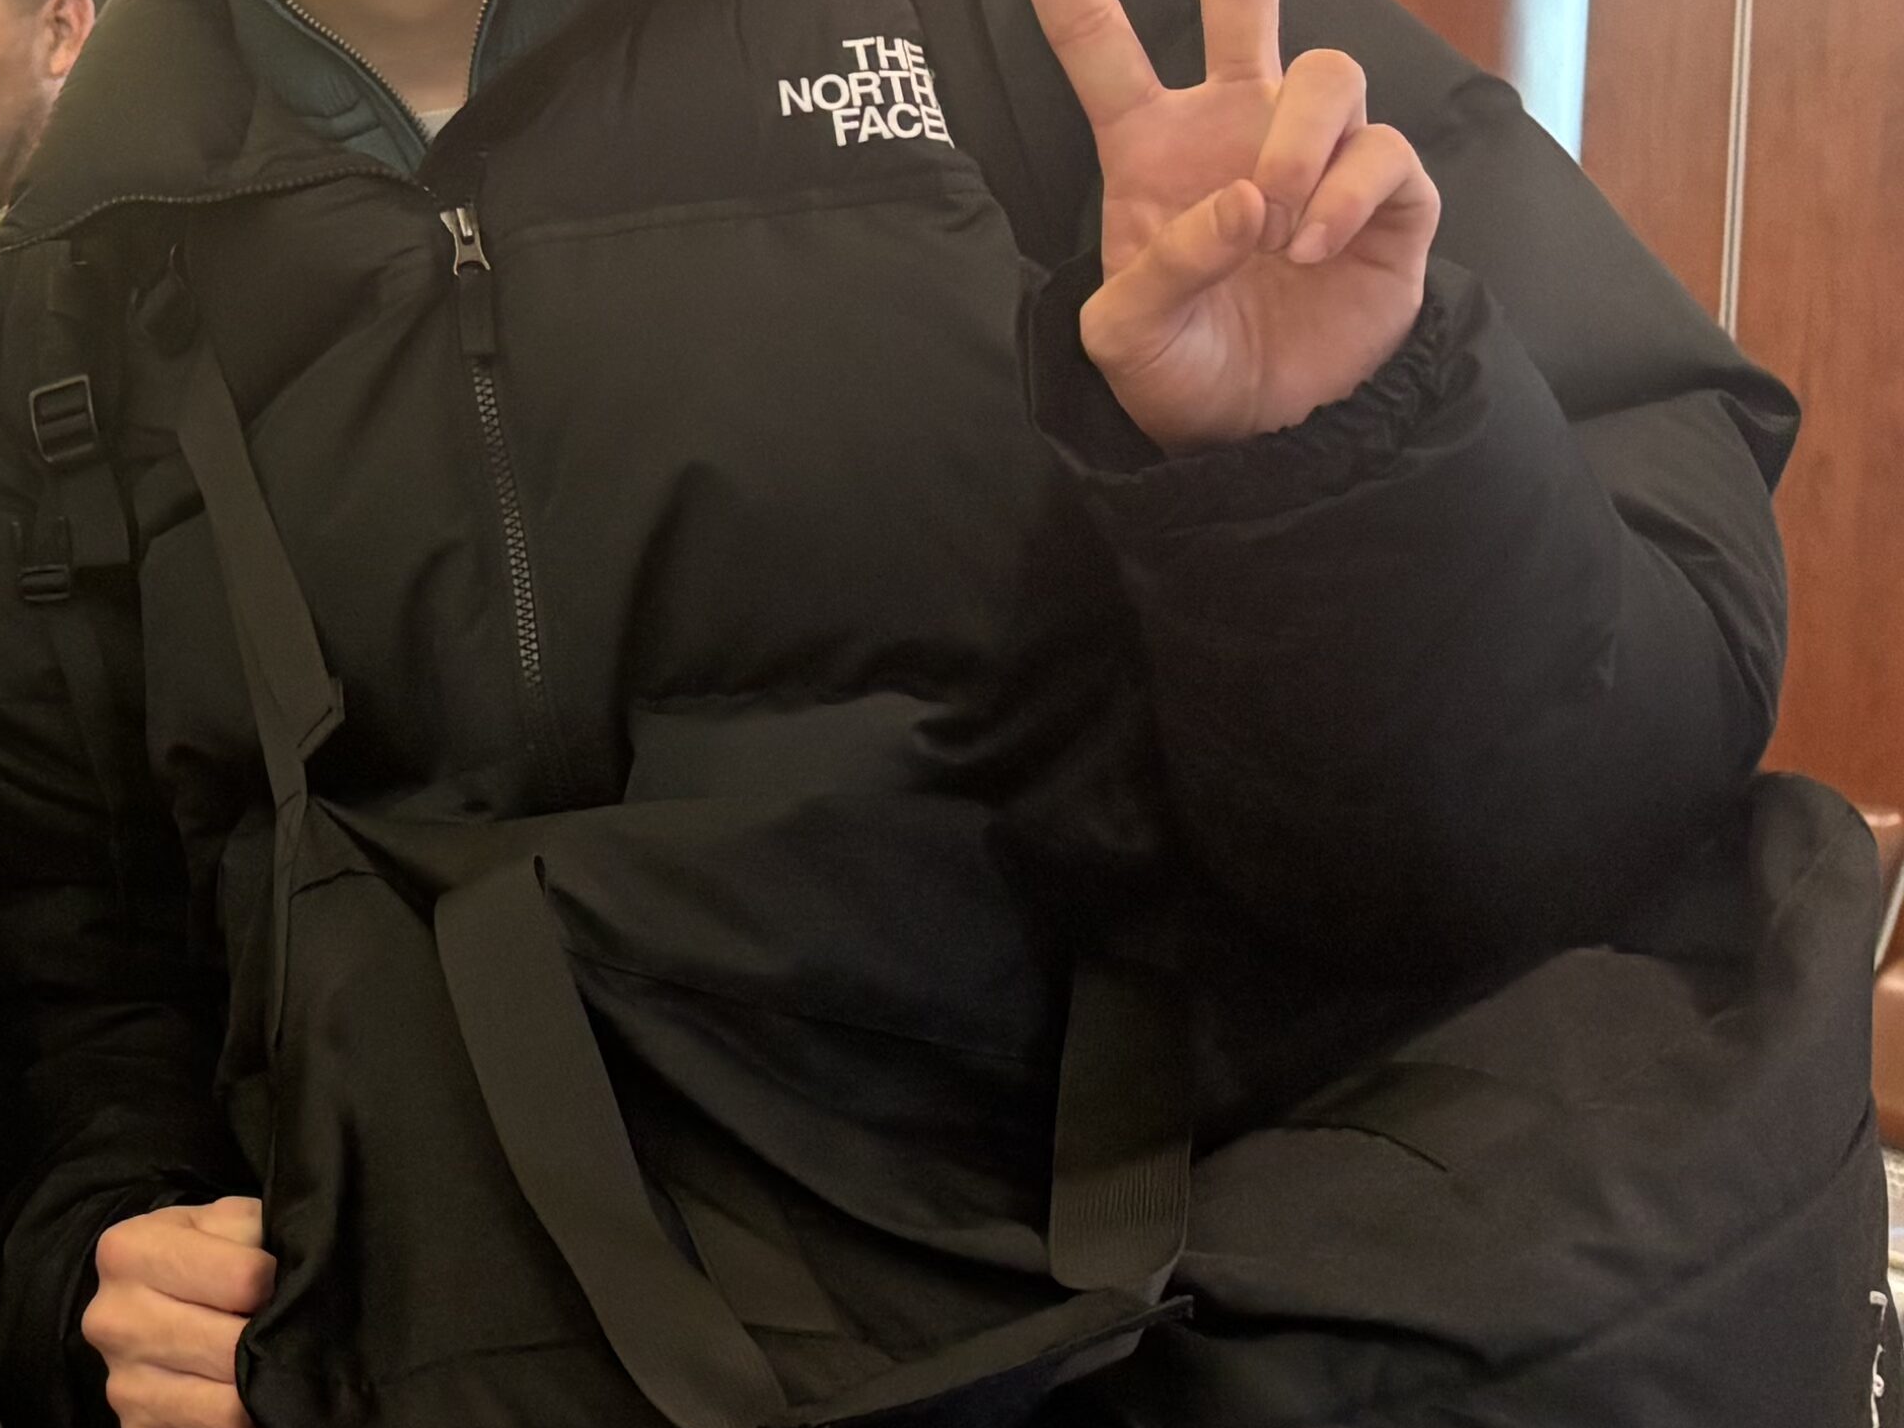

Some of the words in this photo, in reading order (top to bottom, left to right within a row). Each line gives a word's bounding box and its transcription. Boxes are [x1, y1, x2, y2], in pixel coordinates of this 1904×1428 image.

[842, 35, 930, 72] THE
[778, 70, 941, 117] NORTH
[832, 103, 954, 148] FACE
